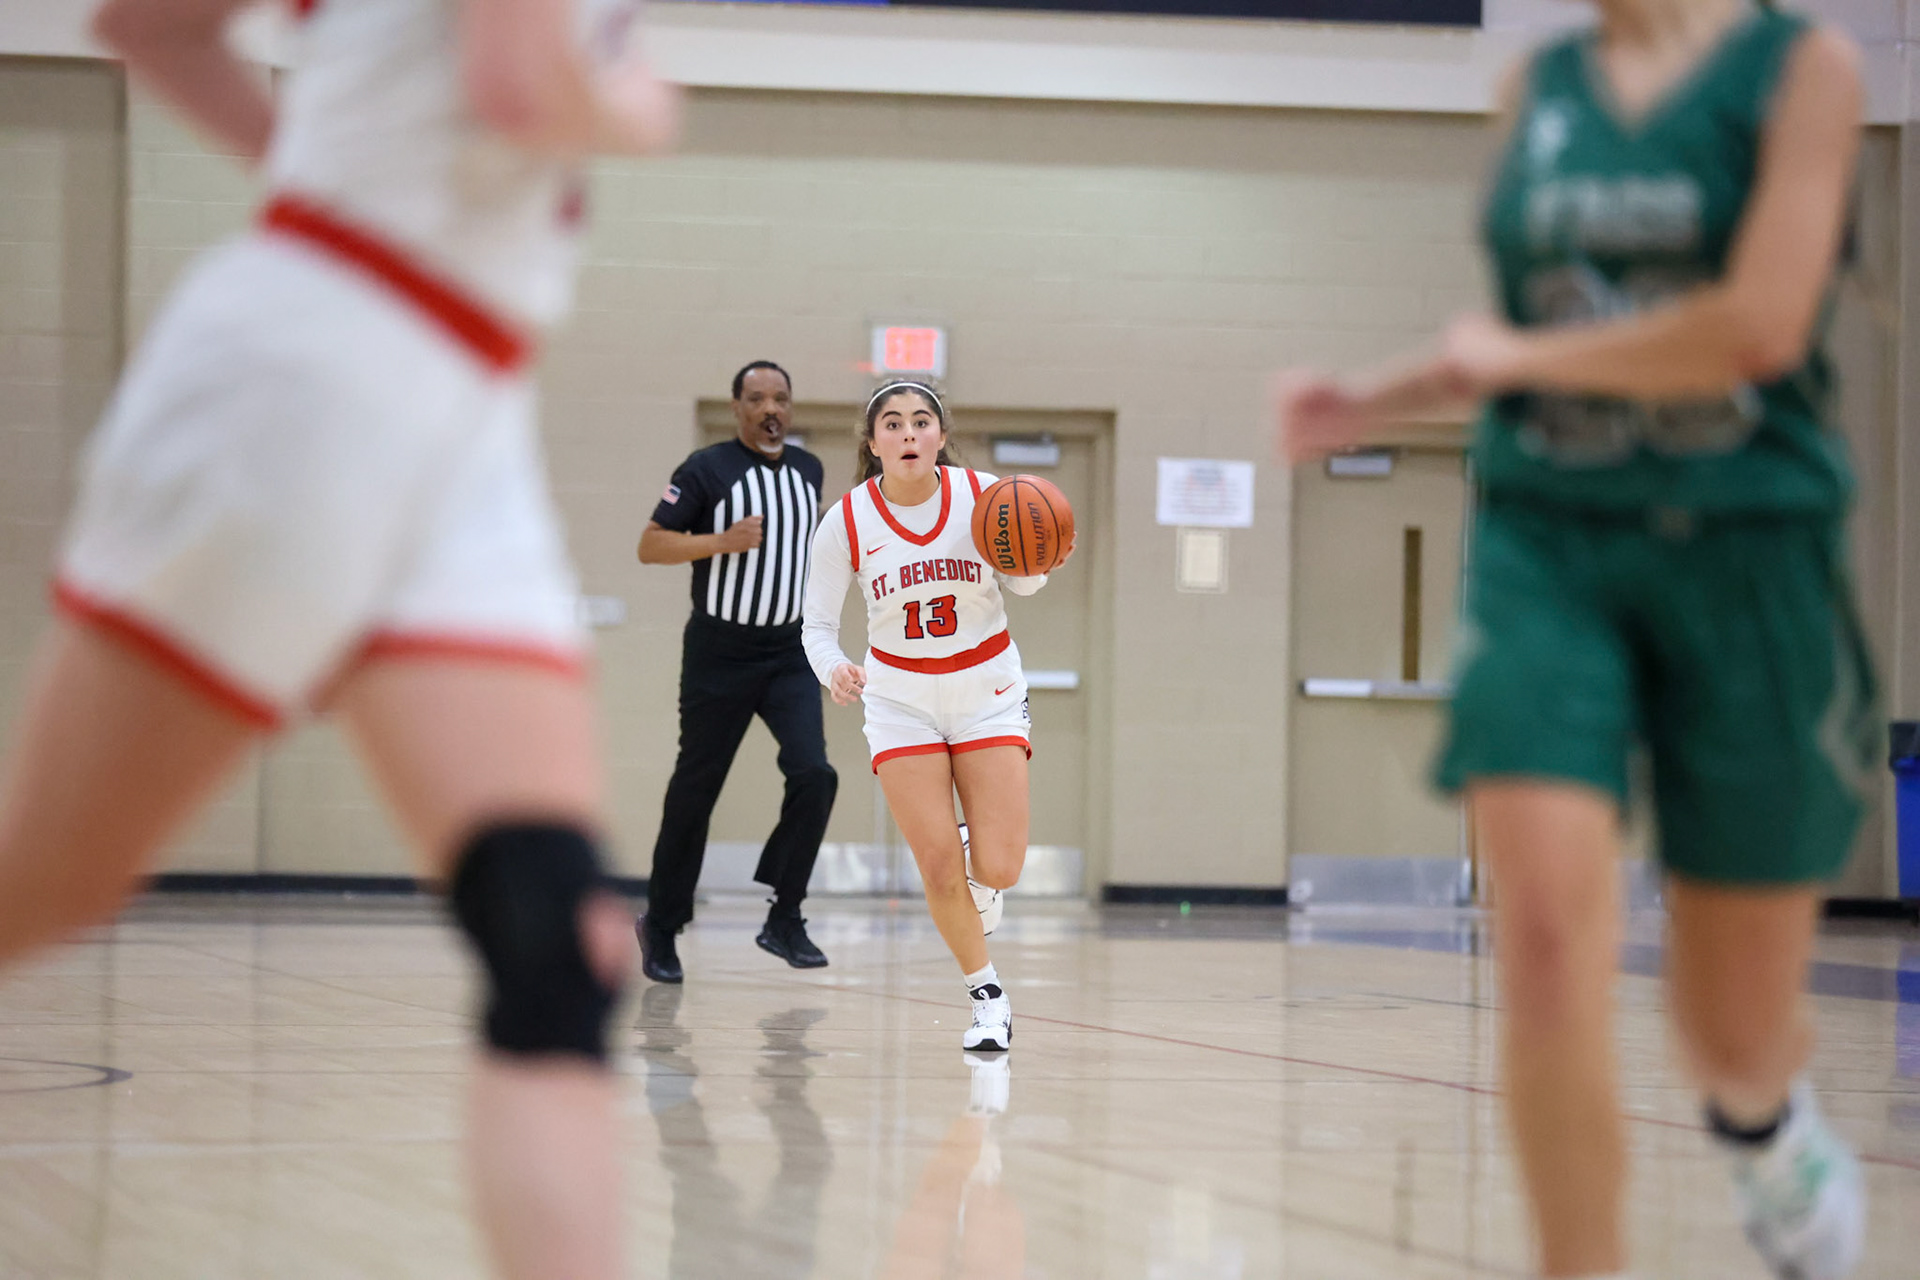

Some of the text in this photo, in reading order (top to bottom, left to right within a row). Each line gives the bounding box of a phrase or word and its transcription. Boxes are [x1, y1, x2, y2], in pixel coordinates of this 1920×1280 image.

[994, 503, 1016, 569] Wilson
[871, 558, 982, 601] ST. BENEDICT
[902, 594, 958, 639] 13
